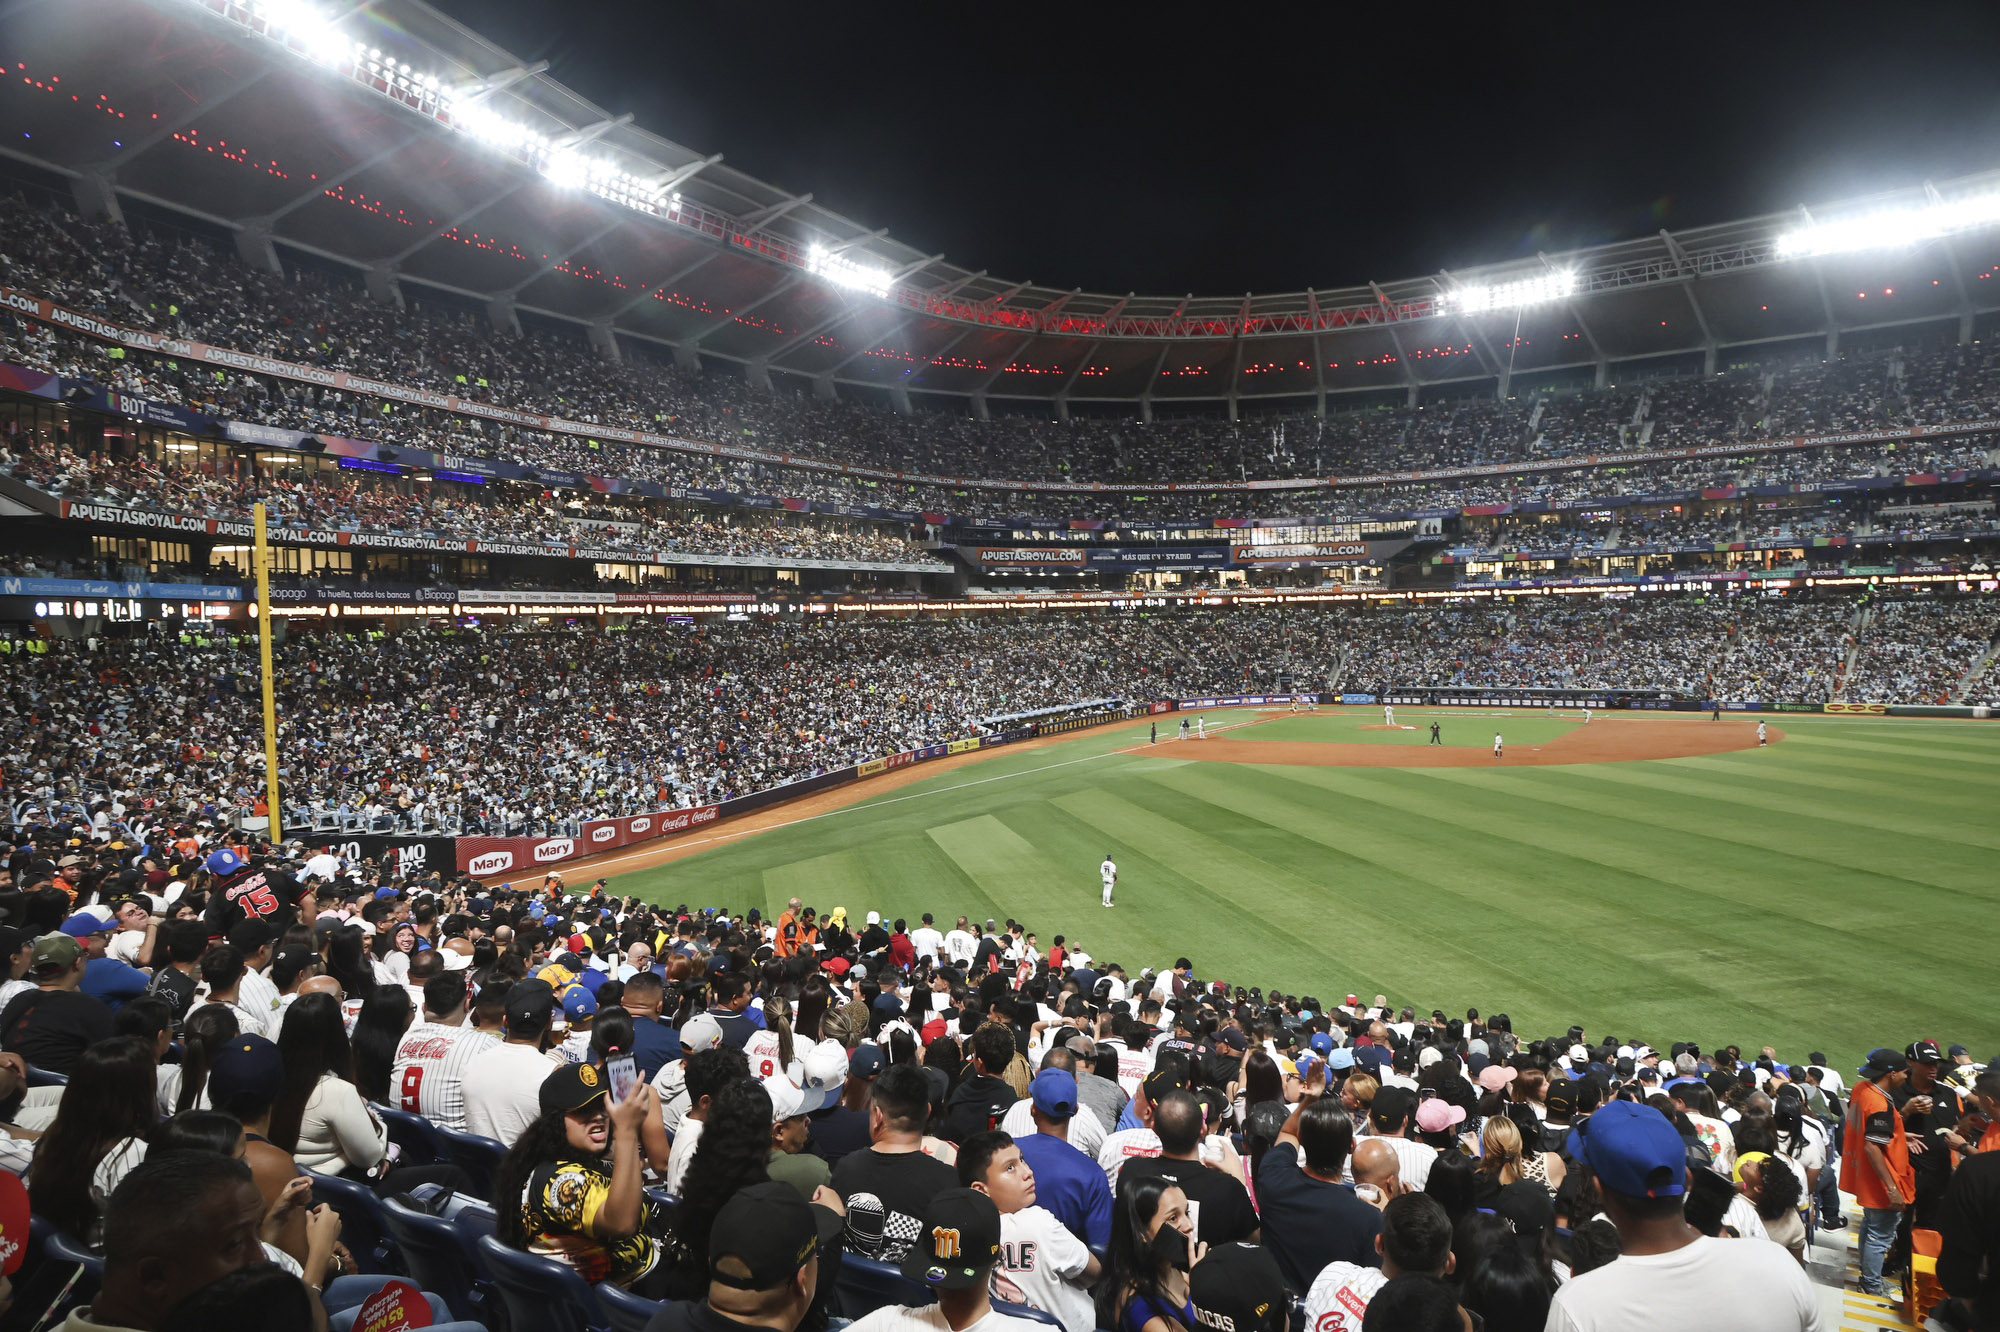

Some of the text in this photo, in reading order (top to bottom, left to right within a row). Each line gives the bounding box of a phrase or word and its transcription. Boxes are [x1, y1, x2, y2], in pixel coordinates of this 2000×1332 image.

[51, 308, 191, 355] APUESTASROYAL.COM
[205, 349, 335, 385] APUESTASROYAL.COM
[345, 378, 449, 407] APUESTASROYAL.COM
[457, 402, 541, 426] APUESTASROYAL.COM
[252, 429, 262, 438] en
[264, 432, 275, 440] un
[549, 420, 634, 440] APUESTASROYAL.COM
[1922, 420, 2000, 435] APUESTASROYA
[641, 434, 714, 452] APUESTASROYAL.COM
[1803, 430, 1911, 446] APUESTASROYAL.COM
[720, 447, 783, 462] APUESTASROYAL.COM
[1696, 440, 1794, 455] APUESTASROYAL.COM
[788, 457, 843, 471] APUESTASROYAL.COM
[1505, 458, 1588, 472] APUESTASROYAL.COM
[847, 466, 898, 479] APUESTASROYAL.COM
[961, 479, 1022, 489] APUESTASROYAL.COM
[1099, 483, 1169, 491] APUESTASROYAL.COM
[69, 503, 206, 532] APUESTASROYAL.COM
[216, 522, 337, 544] APUESTROYAL.COM
[349, 534, 467, 551] APUESTASROYAL.COM
[476, 543, 569, 558] APUESTASROYAL.COM
[574, 549, 654, 563] APUESTASROYAL.COM
[981, 551, 1082, 561] APUESTASROYAL.COM
[1121, 552, 1136, 560] MÁS
[1239, 545, 1365, 559] APUESTASROYAL.COM
[317, 590, 411, 600] Tu huella, todos los bancos
[424, 590, 455, 602] Biopago
[662, 814, 689, 832] Coca-Cola
[691, 807, 717, 825] Coca-Cola
[633, 821, 648, 831] Mary
[595, 829, 613, 839] Mary
[398, 843, 426, 863] MO
[538, 843, 570, 858] Mary
[474, 856, 508, 871] Mary
[238, 885, 279, 919] 15
[398, 1037, 455, 1060] Coca-Cola
[760, 1060, 774, 1080] 9
[401, 1066, 423, 1116] 9
[1002, 1241, 1038, 1272] LE
[389, 1306, 404, 1325] 85
